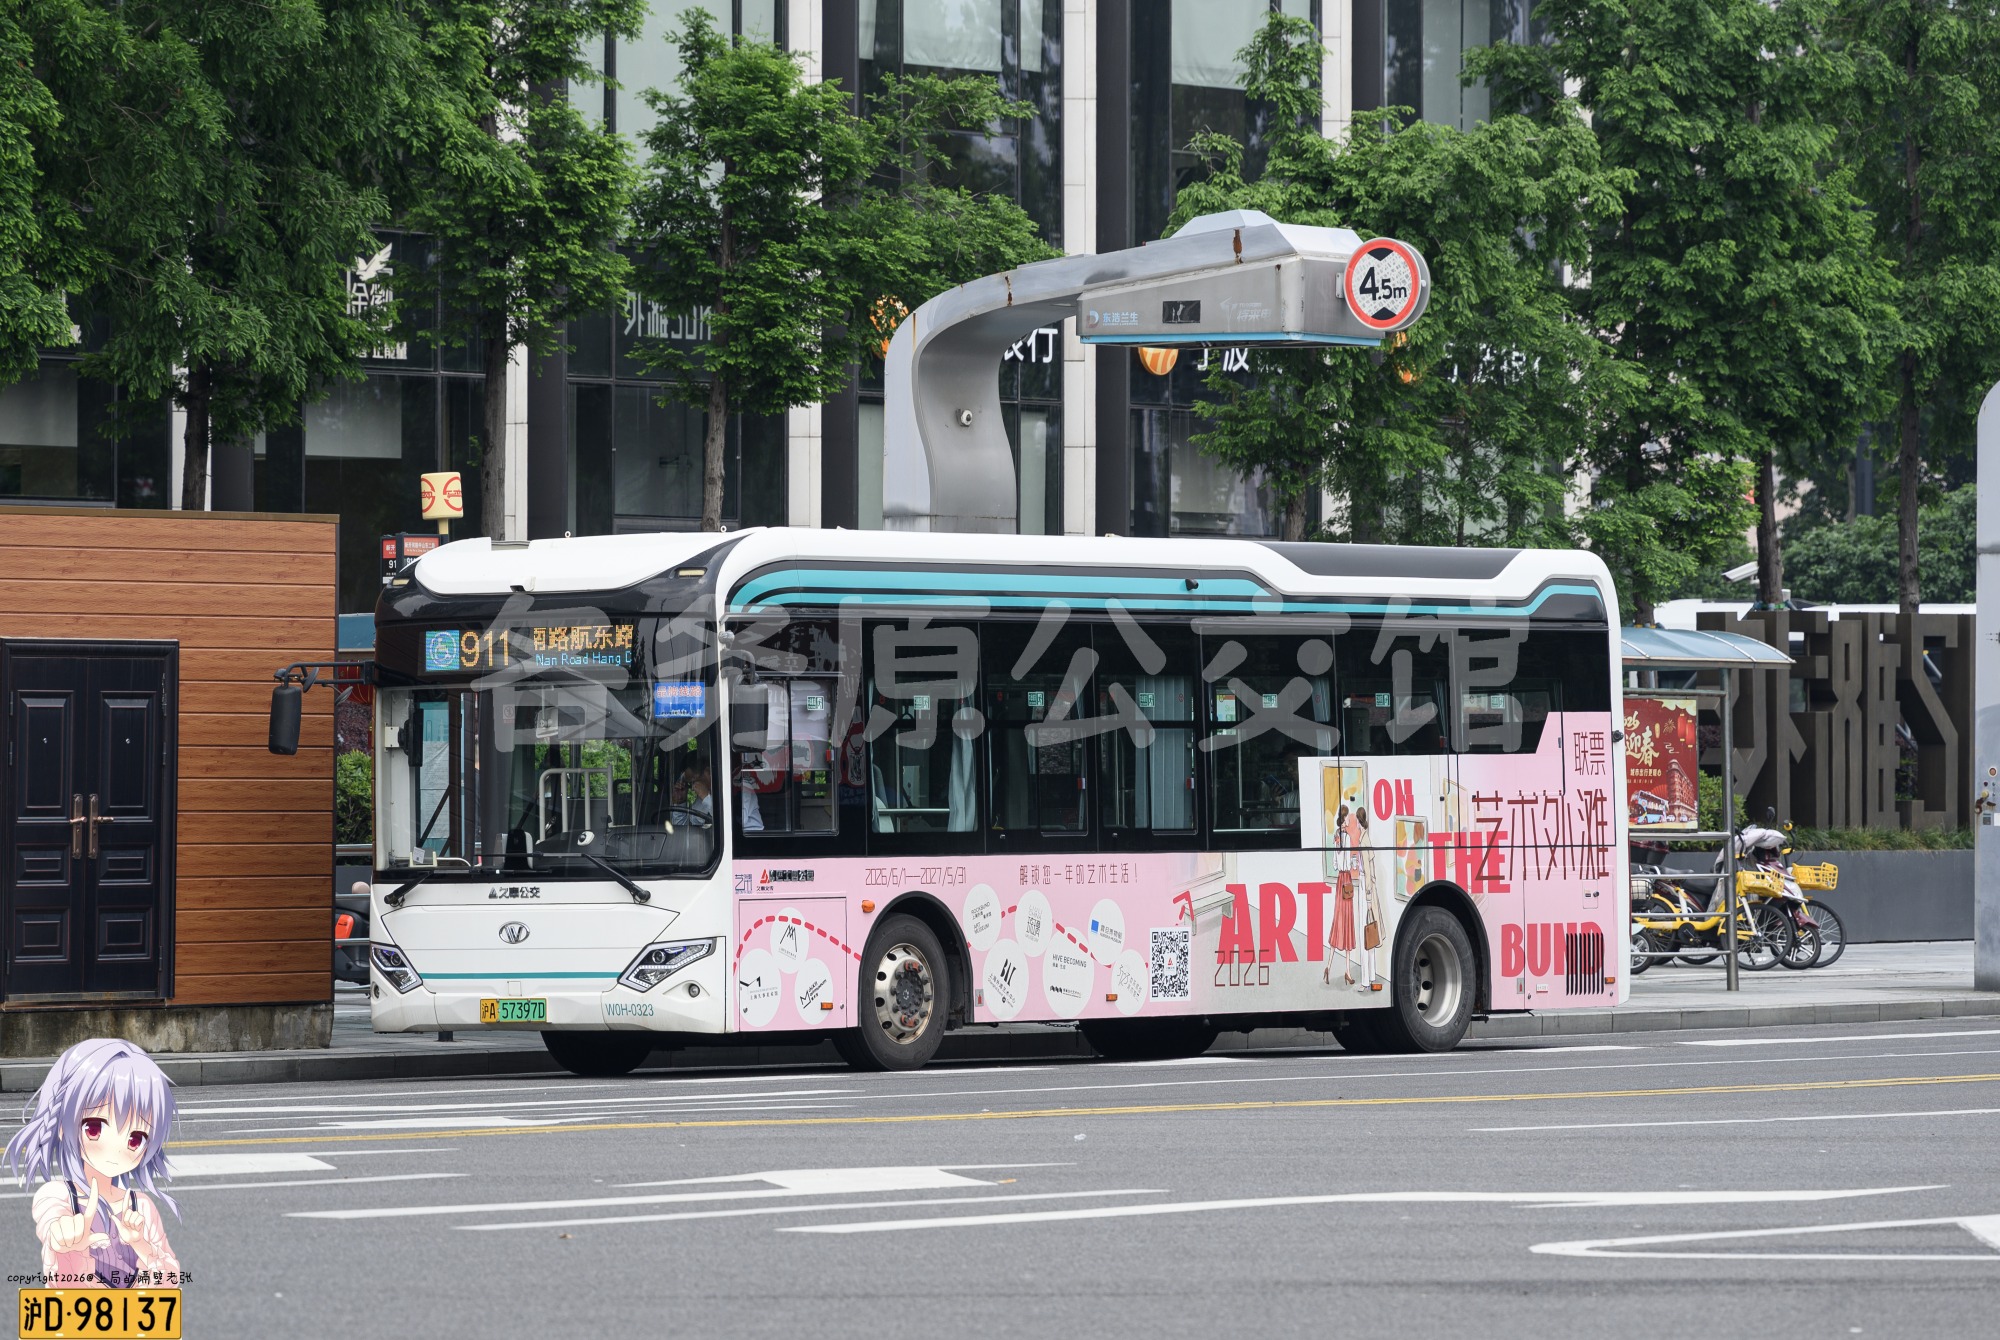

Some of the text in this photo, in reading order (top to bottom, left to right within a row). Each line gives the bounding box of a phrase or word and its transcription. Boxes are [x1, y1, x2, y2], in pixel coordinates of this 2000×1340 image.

[1359, 266, 1407, 301] 4.5m
[1102, 311, 1138, 324] 东浩兰生
[460, 630, 509, 667] 911
[535, 653, 557, 666] Nan
[561, 652, 588, 665] Road
[592, 652, 621, 667] Hang
[1573, 731, 1606, 776] 联票
[1373, 778, 1414, 820] ON
[1472, 789, 1609, 881] 艺术外滩
[1428, 831, 1510, 894] THE
[1217, 882, 1331, 964] ART
[1215, 949, 1270, 987] 2026
[1500, 921, 1604, 977] BUND
